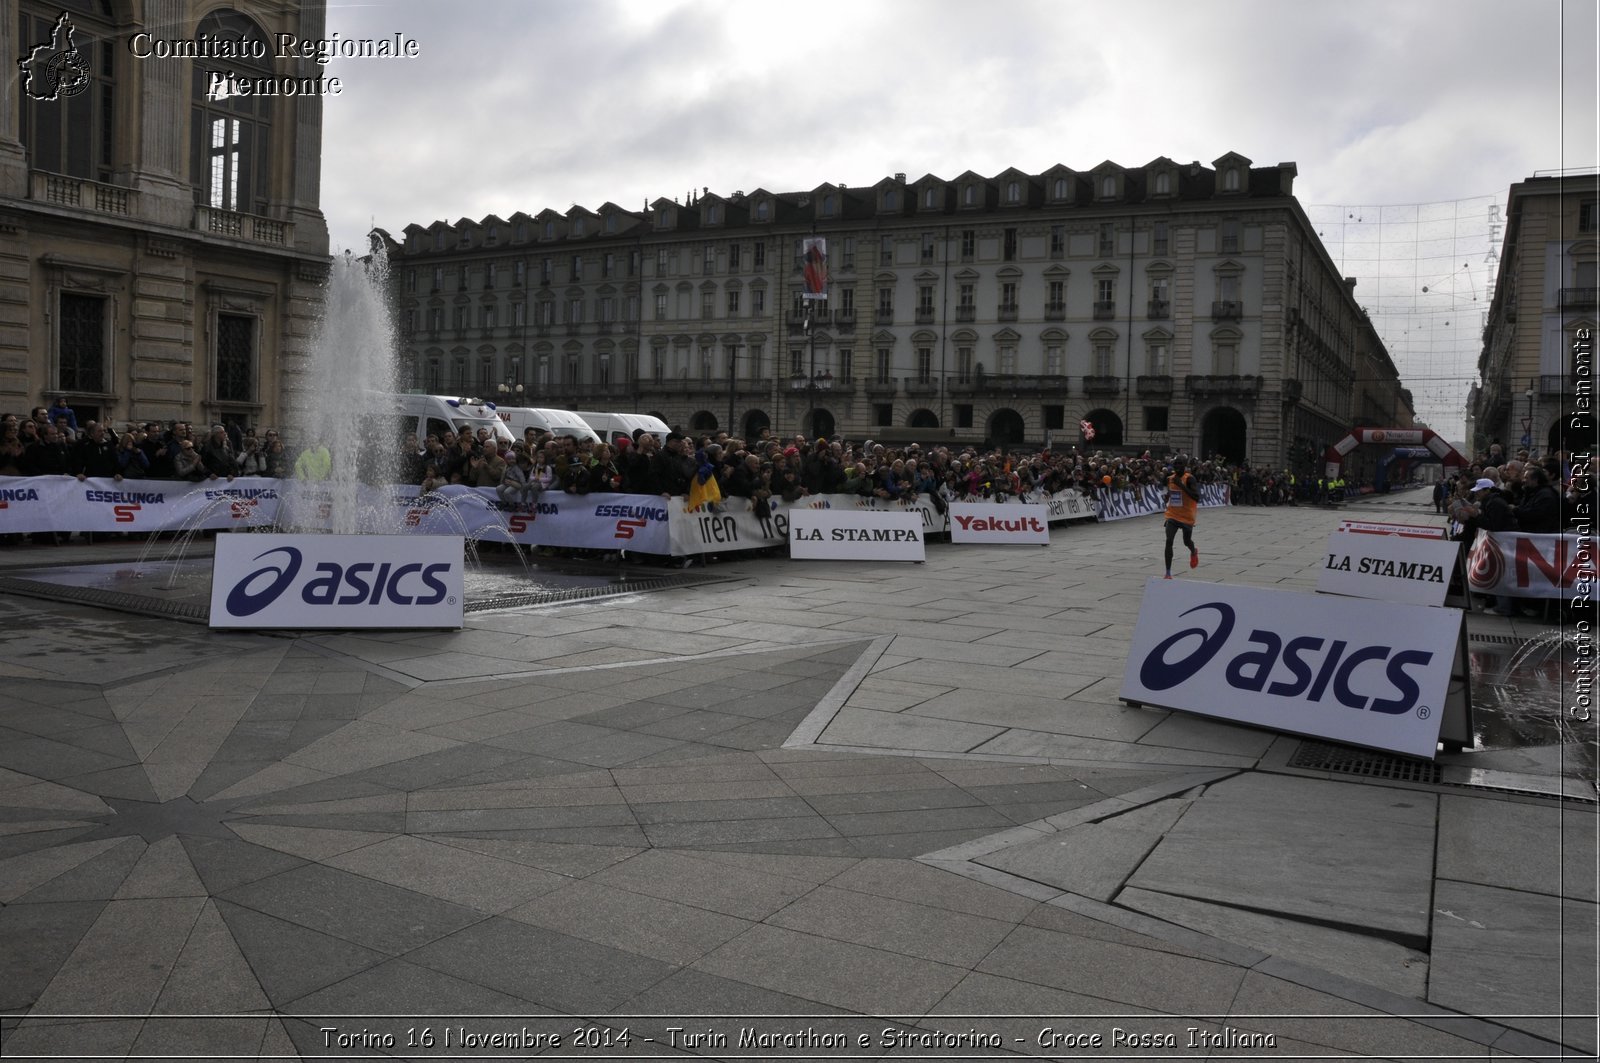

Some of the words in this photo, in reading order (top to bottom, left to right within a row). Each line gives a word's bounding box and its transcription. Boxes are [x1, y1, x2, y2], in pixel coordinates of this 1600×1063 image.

[86, 490, 164, 504] ESSELUNGA
[795, 527, 824, 542] LA
[831, 527, 920, 543] STAMPA
[953, 515, 1045, 533] Yakult
[1325, 553, 1352, 572] LA
[1357, 556, 1445, 584] STAMPA
[301, 562, 452, 605] asics
[1225, 629, 1434, 715] asics
